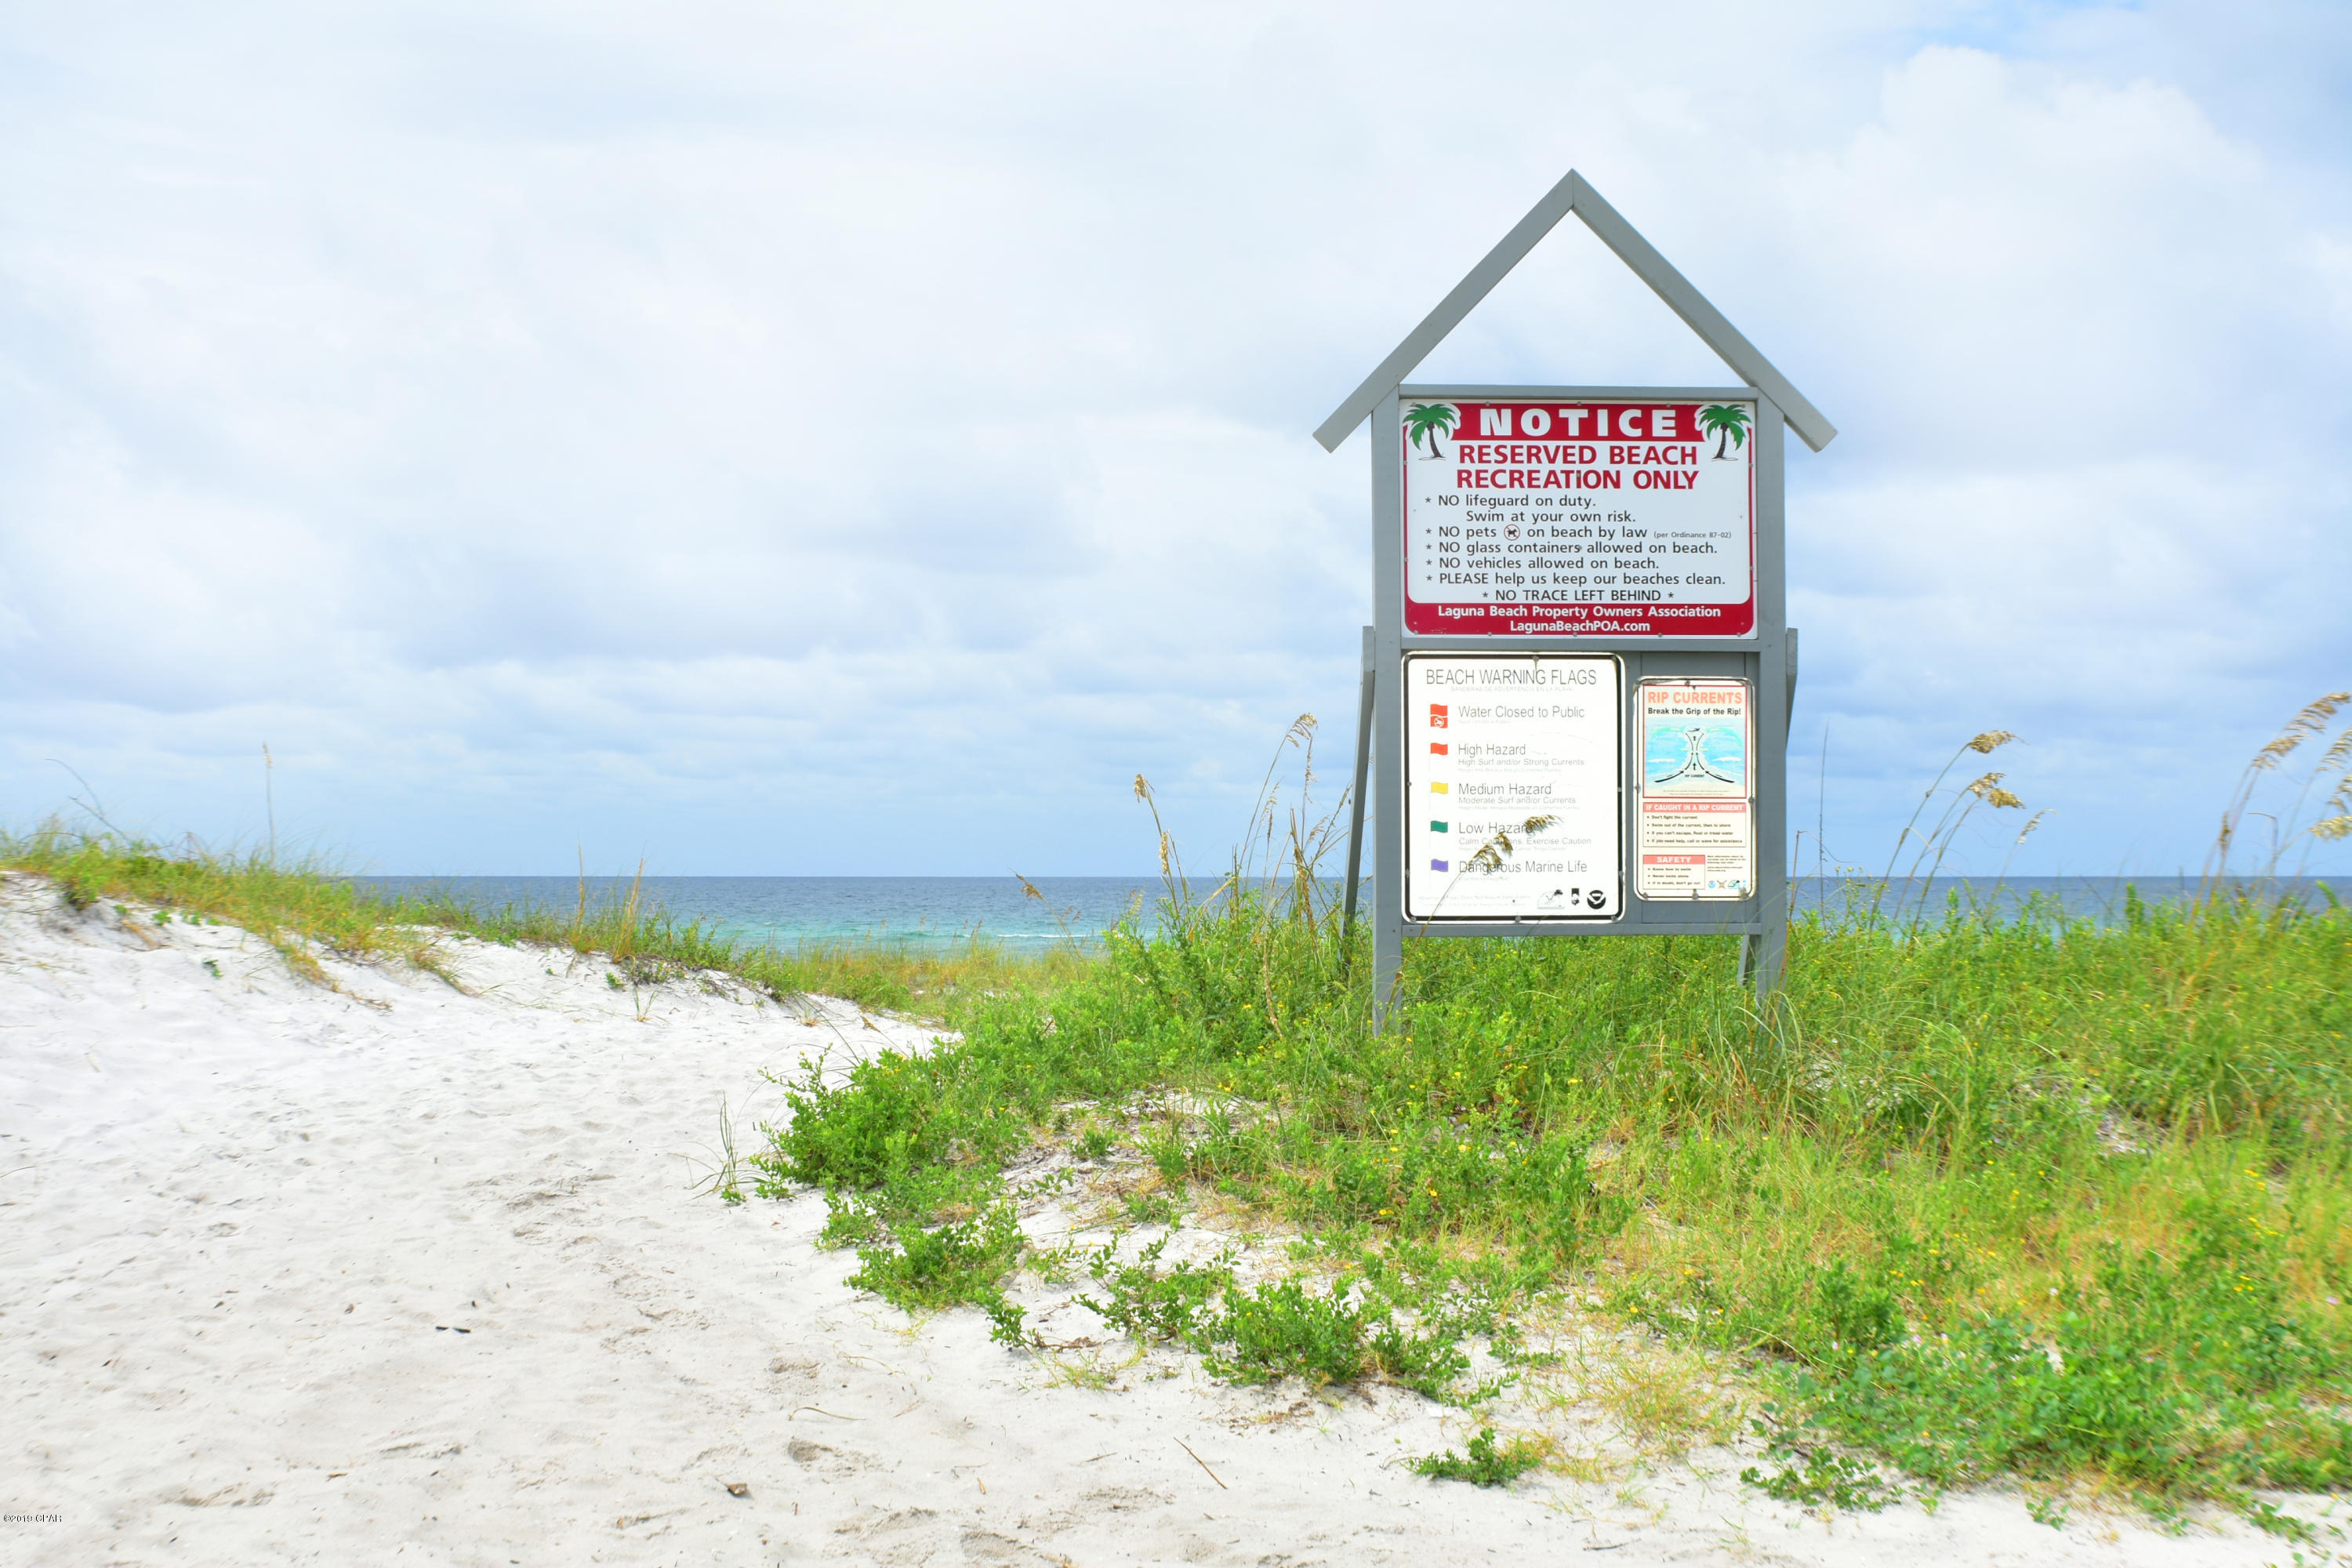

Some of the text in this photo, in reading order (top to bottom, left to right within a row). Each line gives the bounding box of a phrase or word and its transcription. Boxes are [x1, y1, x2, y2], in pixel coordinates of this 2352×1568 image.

[1480, 408, 1676, 437] NOTICE
[1460, 445, 1697, 465] RESERVED BEACH
[1457, 470, 1699, 489] RECREATION ONLY
[1438, 494, 1596, 510] NO lifeguard on duty.
[1466, 510, 1636, 525] Swim at your own risk.
[1439, 525, 1461, 538] NO
[1466, 527, 1497, 540] pets
[1526, 528, 1545, 538] on
[1551, 524, 1592, 538] beach
[1599, 525, 1616, 541] by
[1622, 525, 1648, 538] law
[1653, 531, 1668, 539] (per
[1439, 540, 1718, 557] NO glass containers allowed on beach.
[1439, 556, 1659, 569] NO vehicles allowed on beach.
[1439, 572, 1726, 588] PLEASE help us keep our beaches clean.
[1495, 590, 1661, 601] NO TRACE LEFT BEHIND
[1439, 605, 1721, 619] Laguna Beach Property Owners Association
[1511, 620, 1650, 633] LagunaBeachPOA.com
[1426, 669, 1597, 686] BEACH WARNING FLAGS
[1648, 691, 1742, 704] RIP CURRENTS
[1459, 706, 1584, 717] Water Closed to Public
[1686, 707, 1700, 717] Grip
[1727, 707, 1740, 717] Rip!
[1459, 743, 1525, 757] High Hazard
[1458, 758, 1475, 767] High
[1524, 758, 1548, 767] Strong
[1459, 783, 1551, 795] Medium Hazard
[1459, 822, 1483, 833] Low
[1459, 837, 1479, 845] Calm
[1526, 837, 1559, 845] Exercise
[1561, 837, 1592, 845] Caution
[1525, 861, 1563, 873] Marine
[1567, 861, 1588, 873] Life
